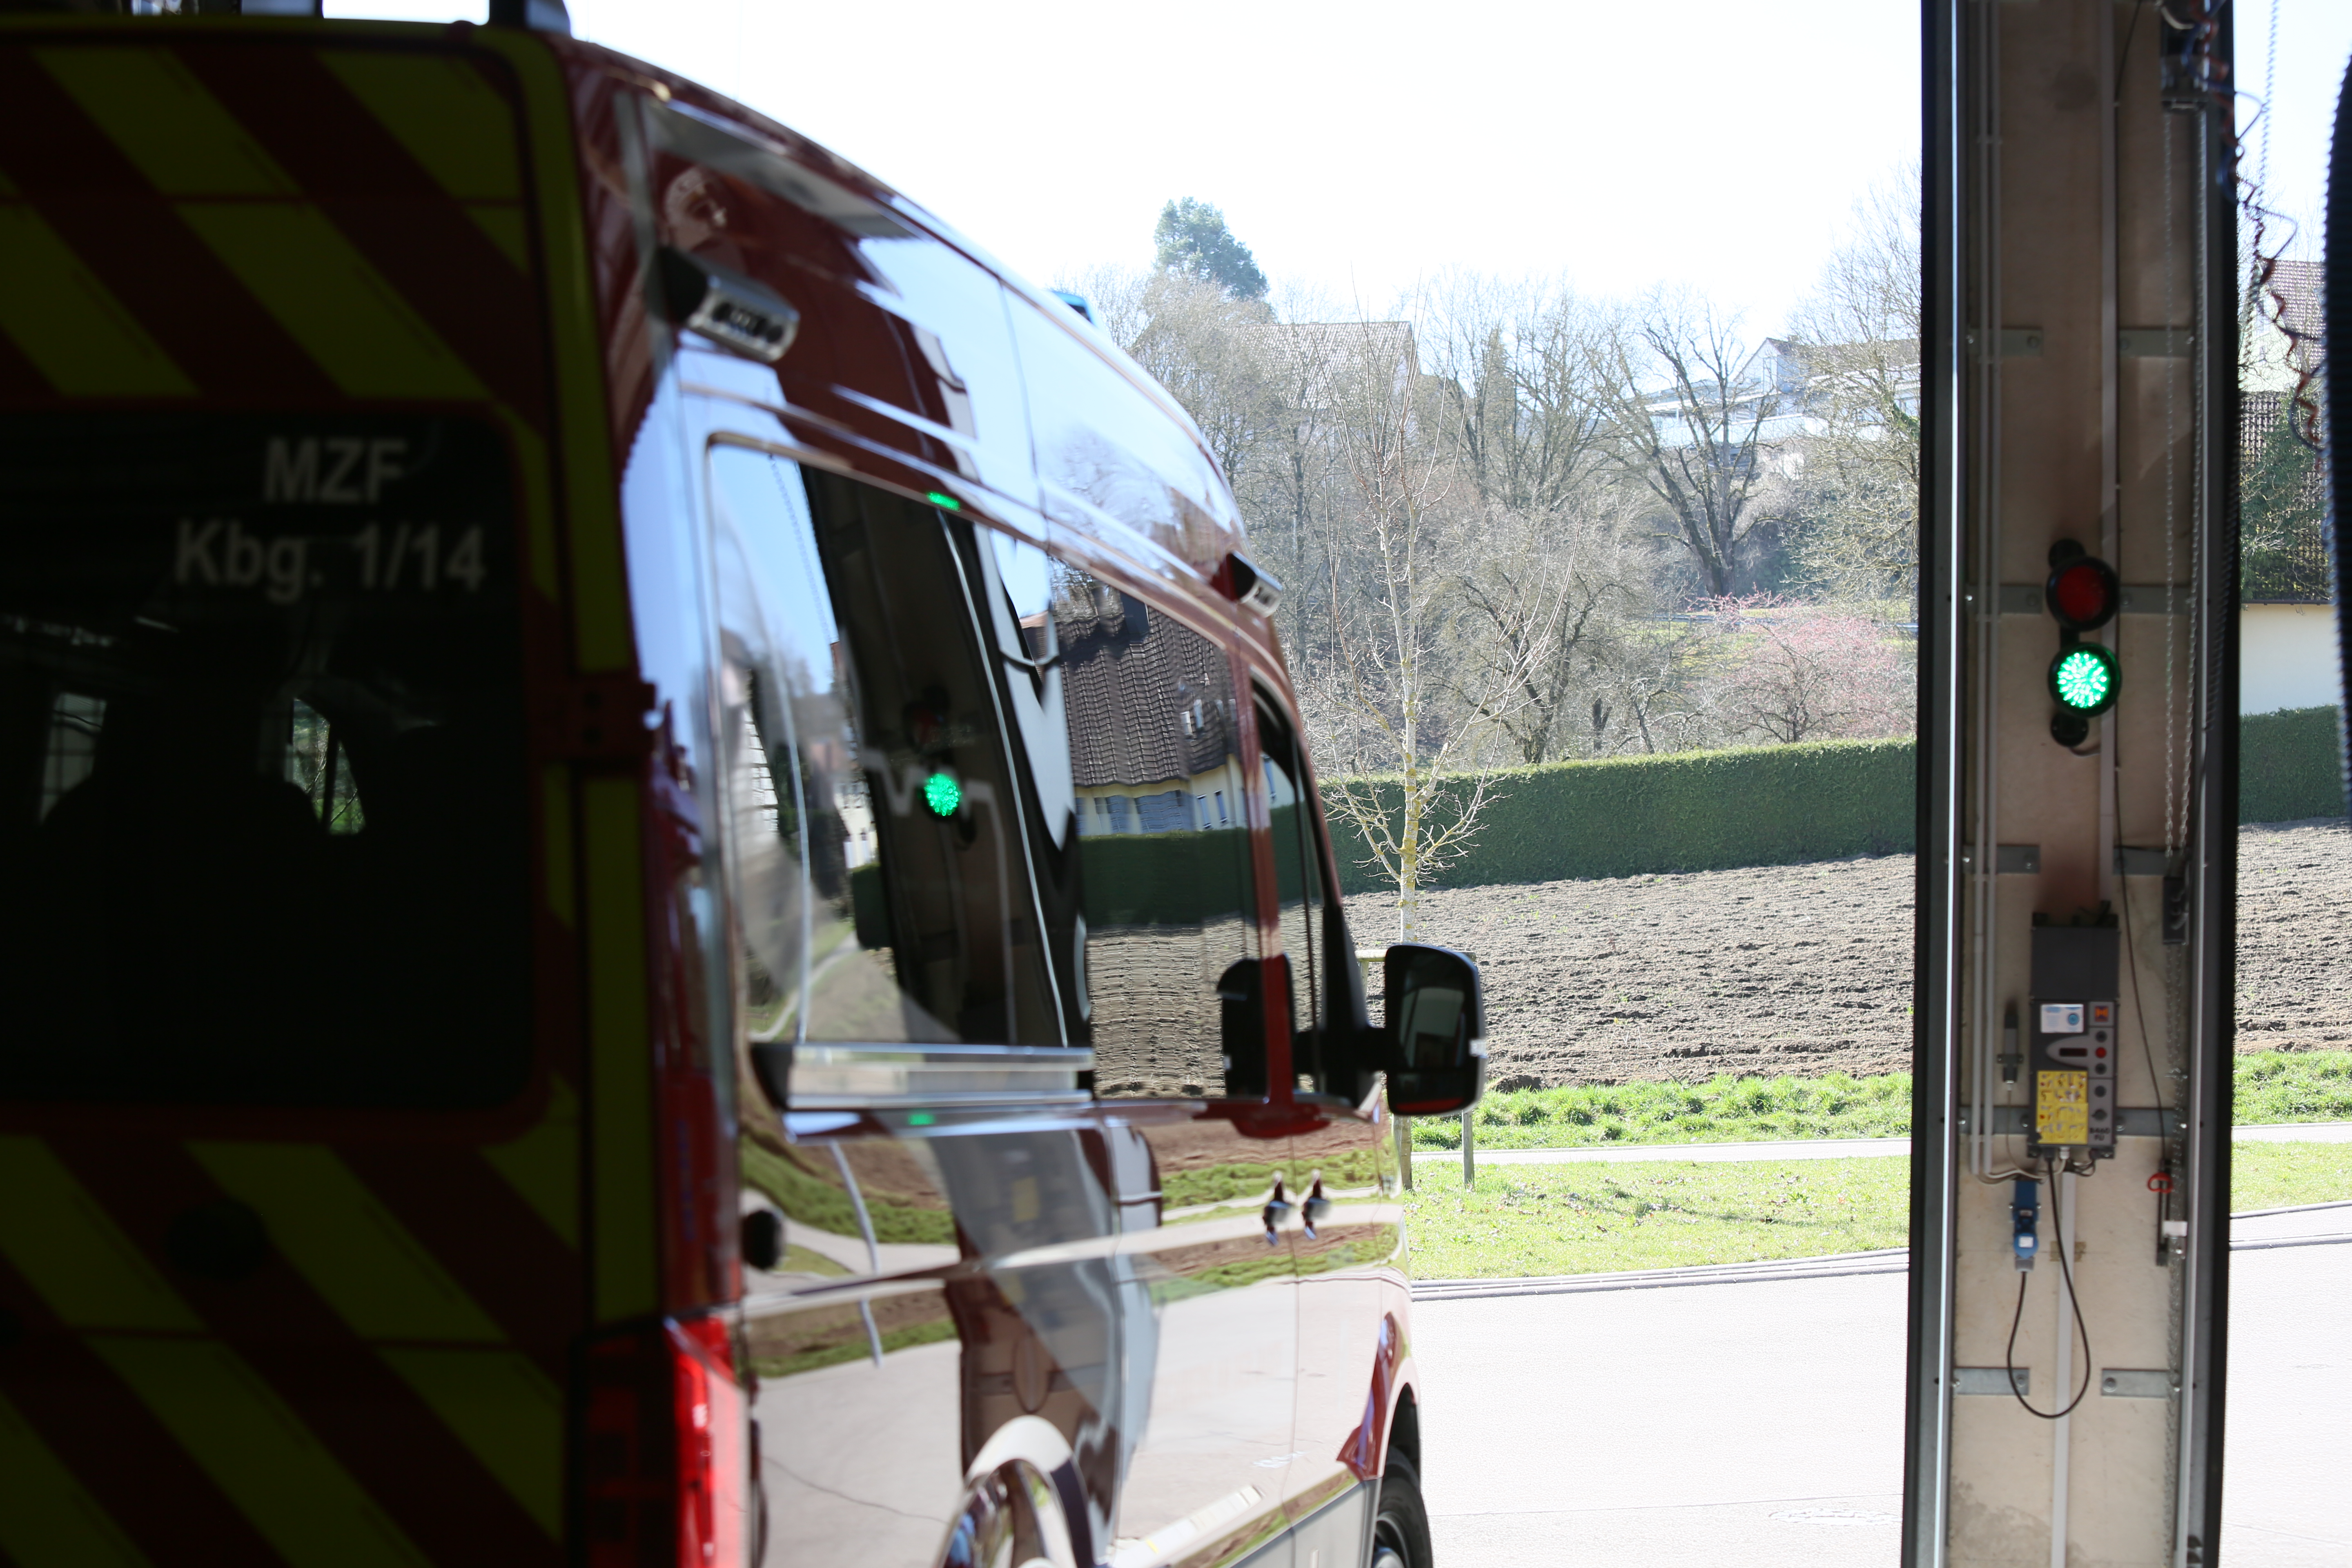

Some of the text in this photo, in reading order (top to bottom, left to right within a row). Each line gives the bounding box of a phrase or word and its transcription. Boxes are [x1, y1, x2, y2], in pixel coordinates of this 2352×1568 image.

[263, 437, 408, 504] MZF
[174, 518, 488, 605] Kbg. 1/14
